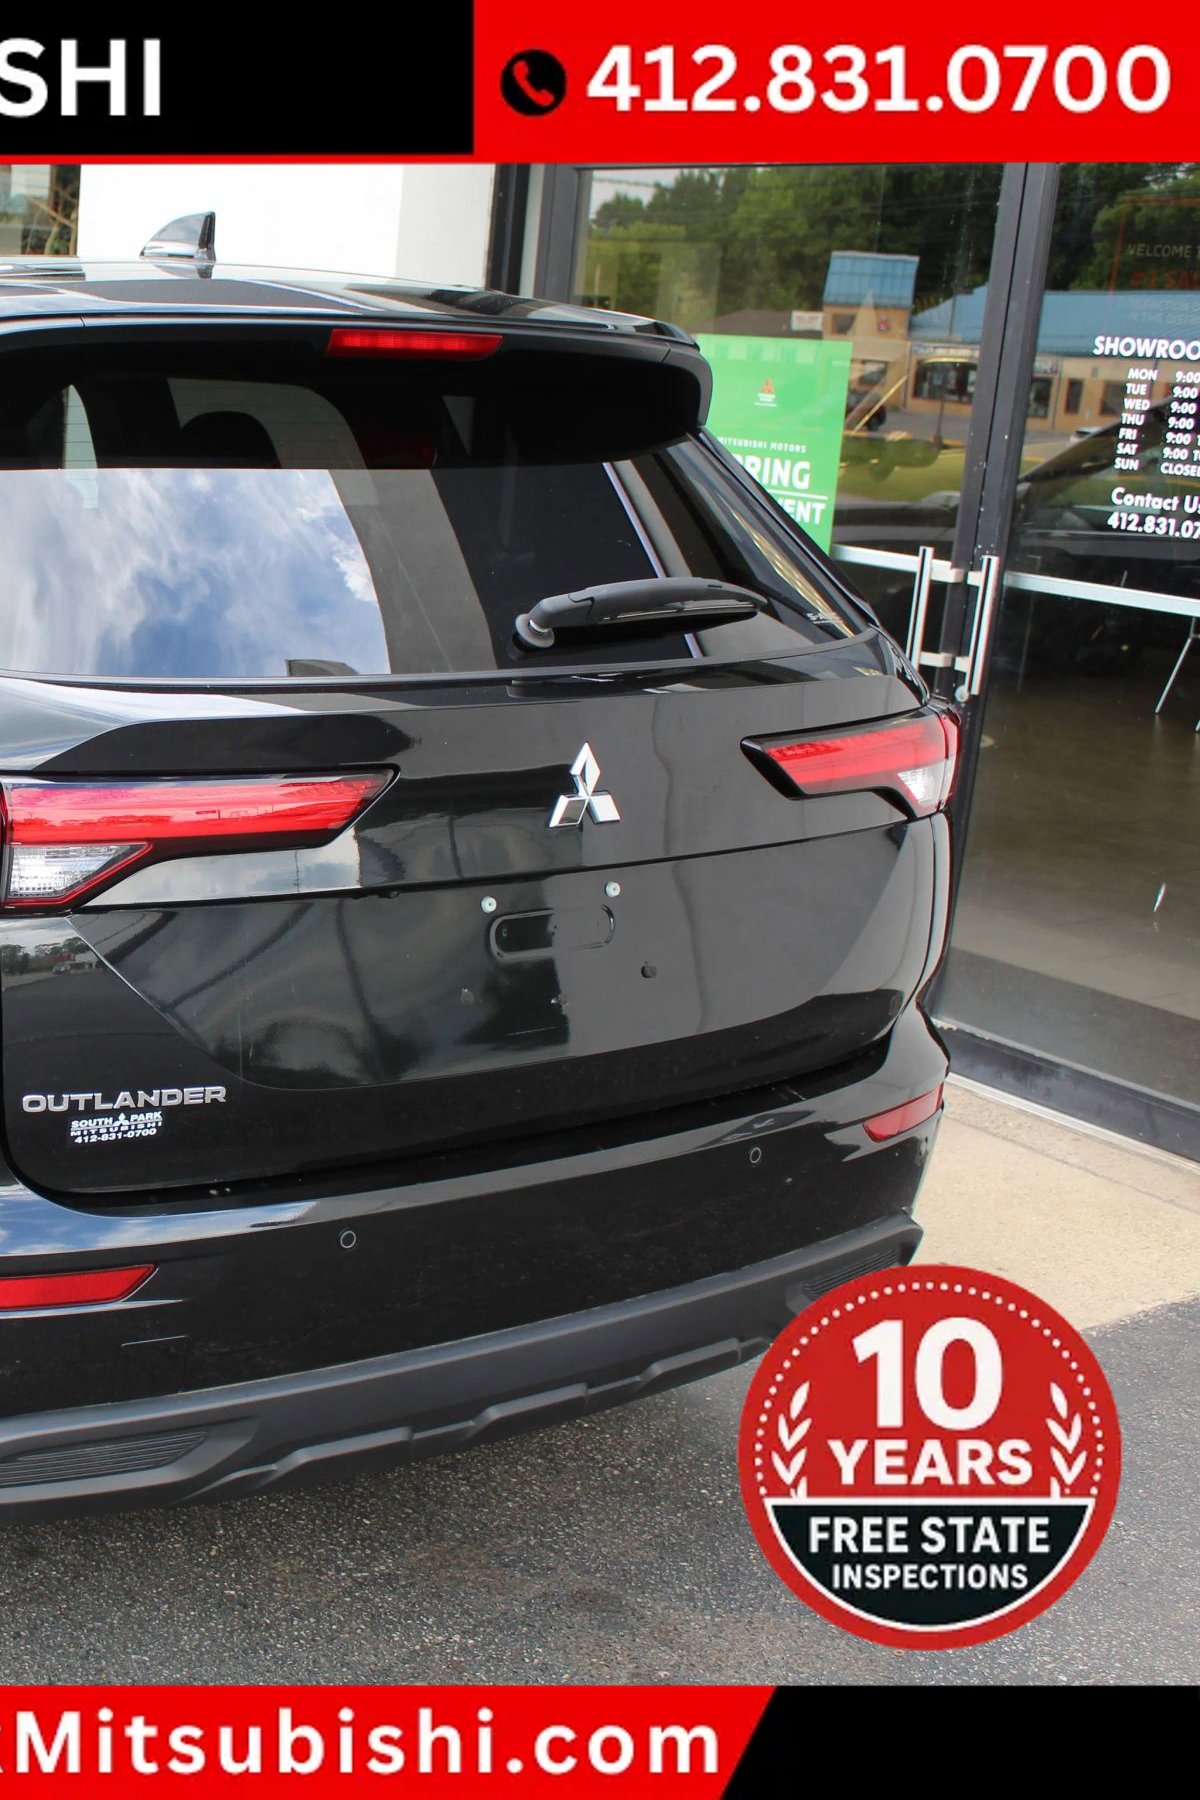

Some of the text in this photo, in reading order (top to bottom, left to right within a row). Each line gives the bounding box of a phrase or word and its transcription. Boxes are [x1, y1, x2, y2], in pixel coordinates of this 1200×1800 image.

[1127, 368, 1158, 380] MON
[1125, 383, 1199, 399] TUE 9:00
[1124, 398, 1197, 414] WED 9:00
[1121, 413, 1195, 430] THU 9:00
[1119, 427, 1138, 440] FRI
[1165, 431, 1191, 445] 9:00
[770, 441, 806, 453] MOTORS
[1116, 442, 1138, 455] SAT
[1163, 447, 1189, 460] 9:00
[1114, 457, 1139, 471] SUN
[1111, 487, 1179, 511] Contact
[22, 1086, 227, 1113] OUTLANDER
[71, 1111, 162, 1129] SOUTH PARK
[70, 1122, 162, 1136] MITSUBISHI
[74, 1128, 157, 1144] 412-831-0700
